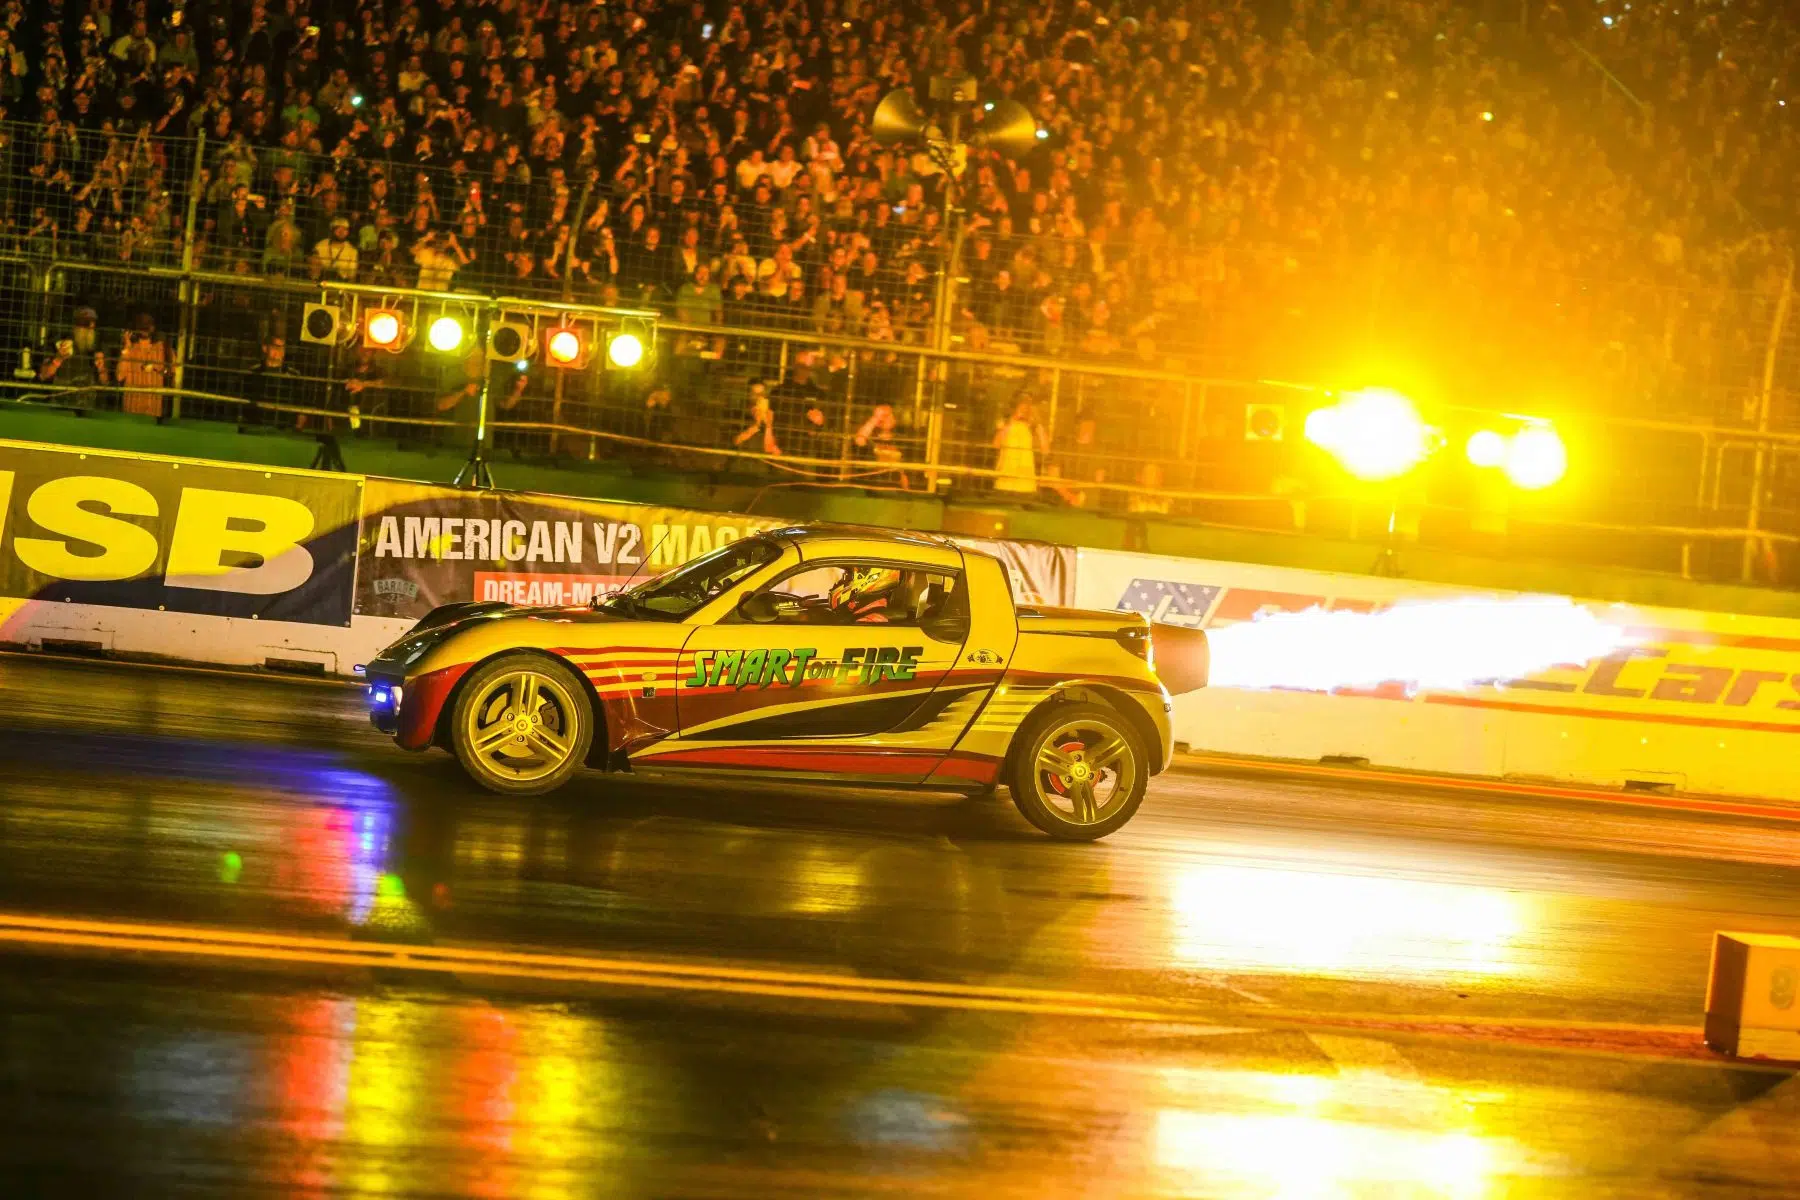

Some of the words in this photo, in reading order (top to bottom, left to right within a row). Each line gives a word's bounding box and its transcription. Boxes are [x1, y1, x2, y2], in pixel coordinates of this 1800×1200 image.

[0, 470, 315, 595] SB
[374, 516, 583, 563] AMERICAN
[593, 522, 641, 564] V2
[686, 648, 817, 692] SMART
[836, 646, 924, 687] FIRE
